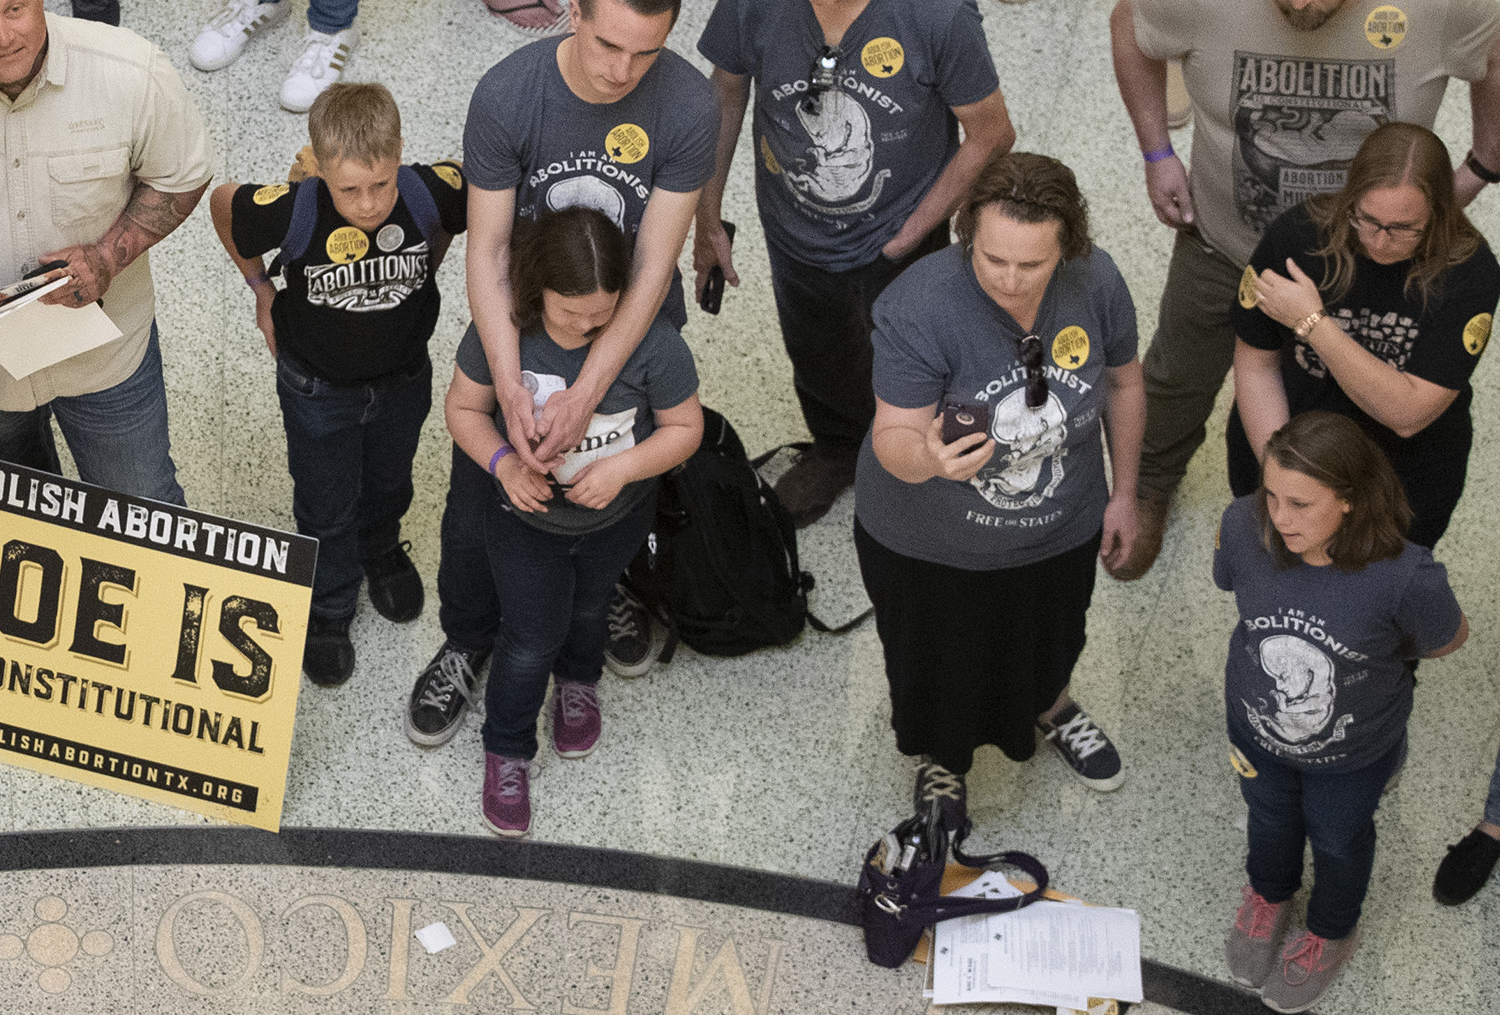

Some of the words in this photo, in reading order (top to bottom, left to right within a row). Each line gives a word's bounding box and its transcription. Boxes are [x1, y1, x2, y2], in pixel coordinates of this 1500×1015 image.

[863, 47, 902, 68] ABORTION
[1240, 58, 1386, 98] ABOLITION
[579, 150, 596, 158] AM
[610, 129, 643, 160] ABORTION
[529, 158, 649, 204] ABOLITIONIS
[1283, 171, 1344, 186] ABORTION
[329, 240, 368, 254] ABORTION
[966, 509, 1004, 527] FREE
[98, 497, 291, 574] ABORTION
[1288, 608, 1304, 617] AM
[1309, 615, 1325, 626] AN
[172, 582, 282, 700] IS
[155, 889, 790, 1015] MEXICO
